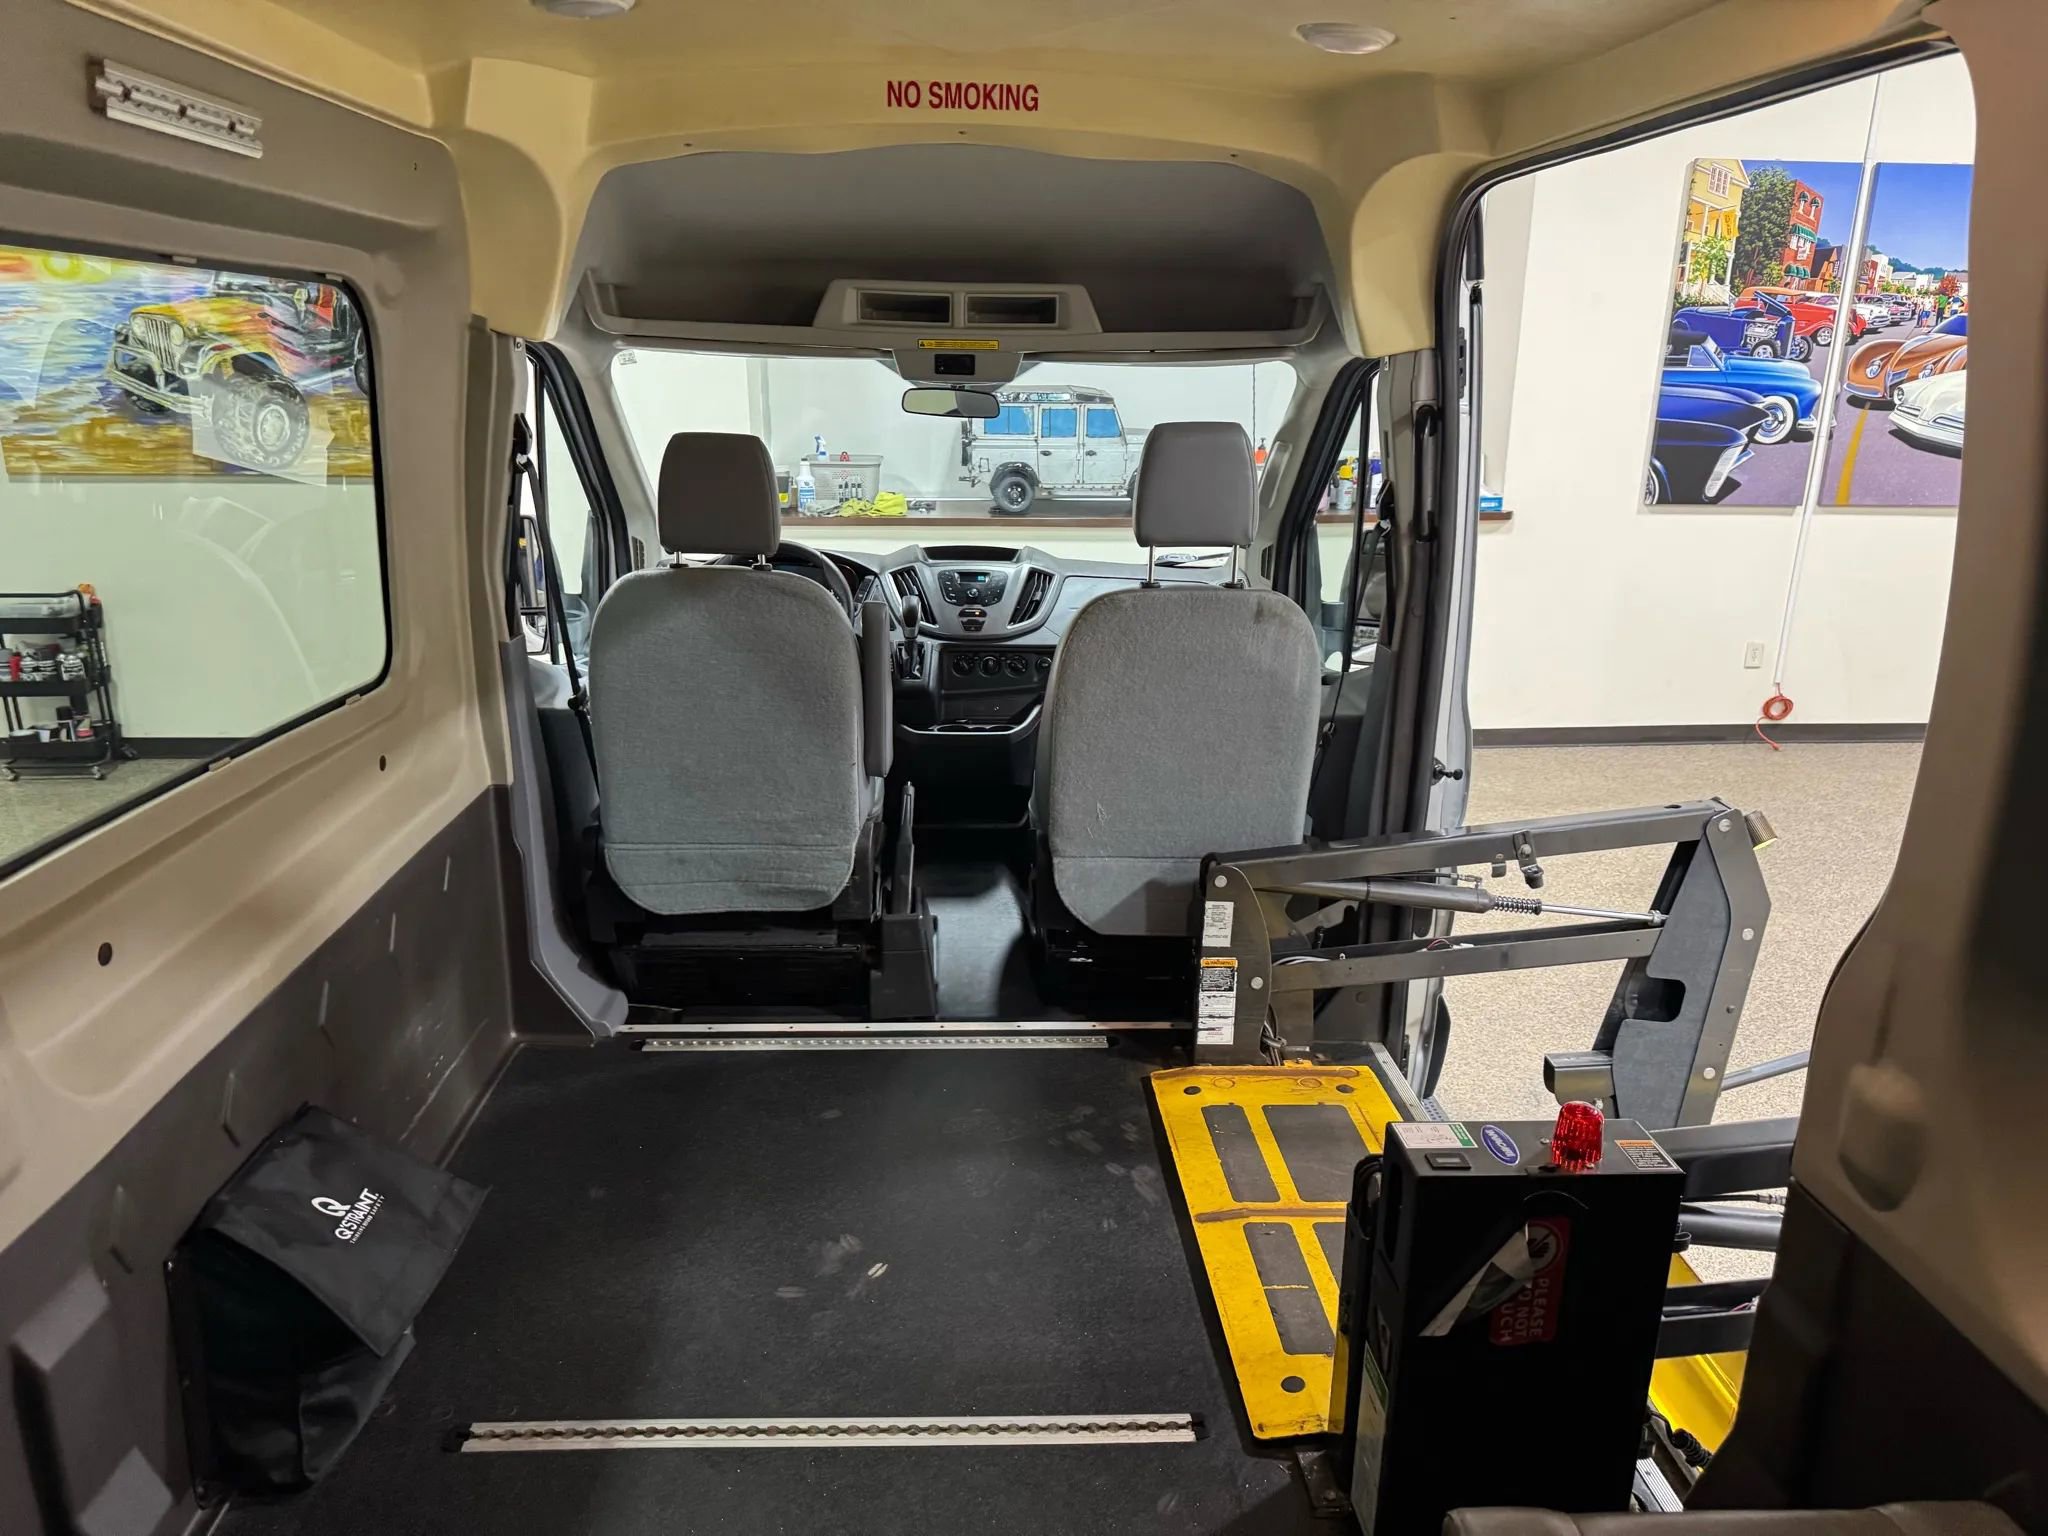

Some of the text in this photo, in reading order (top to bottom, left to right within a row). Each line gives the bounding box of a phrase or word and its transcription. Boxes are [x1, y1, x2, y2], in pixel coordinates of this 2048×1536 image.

[887, 80, 1039, 112] NO SMOKING
[1499, 1301, 1515, 1341] UCH
[1513, 1305, 1531, 1337] NOT
[1529, 1277, 1550, 1337] PLEASE
